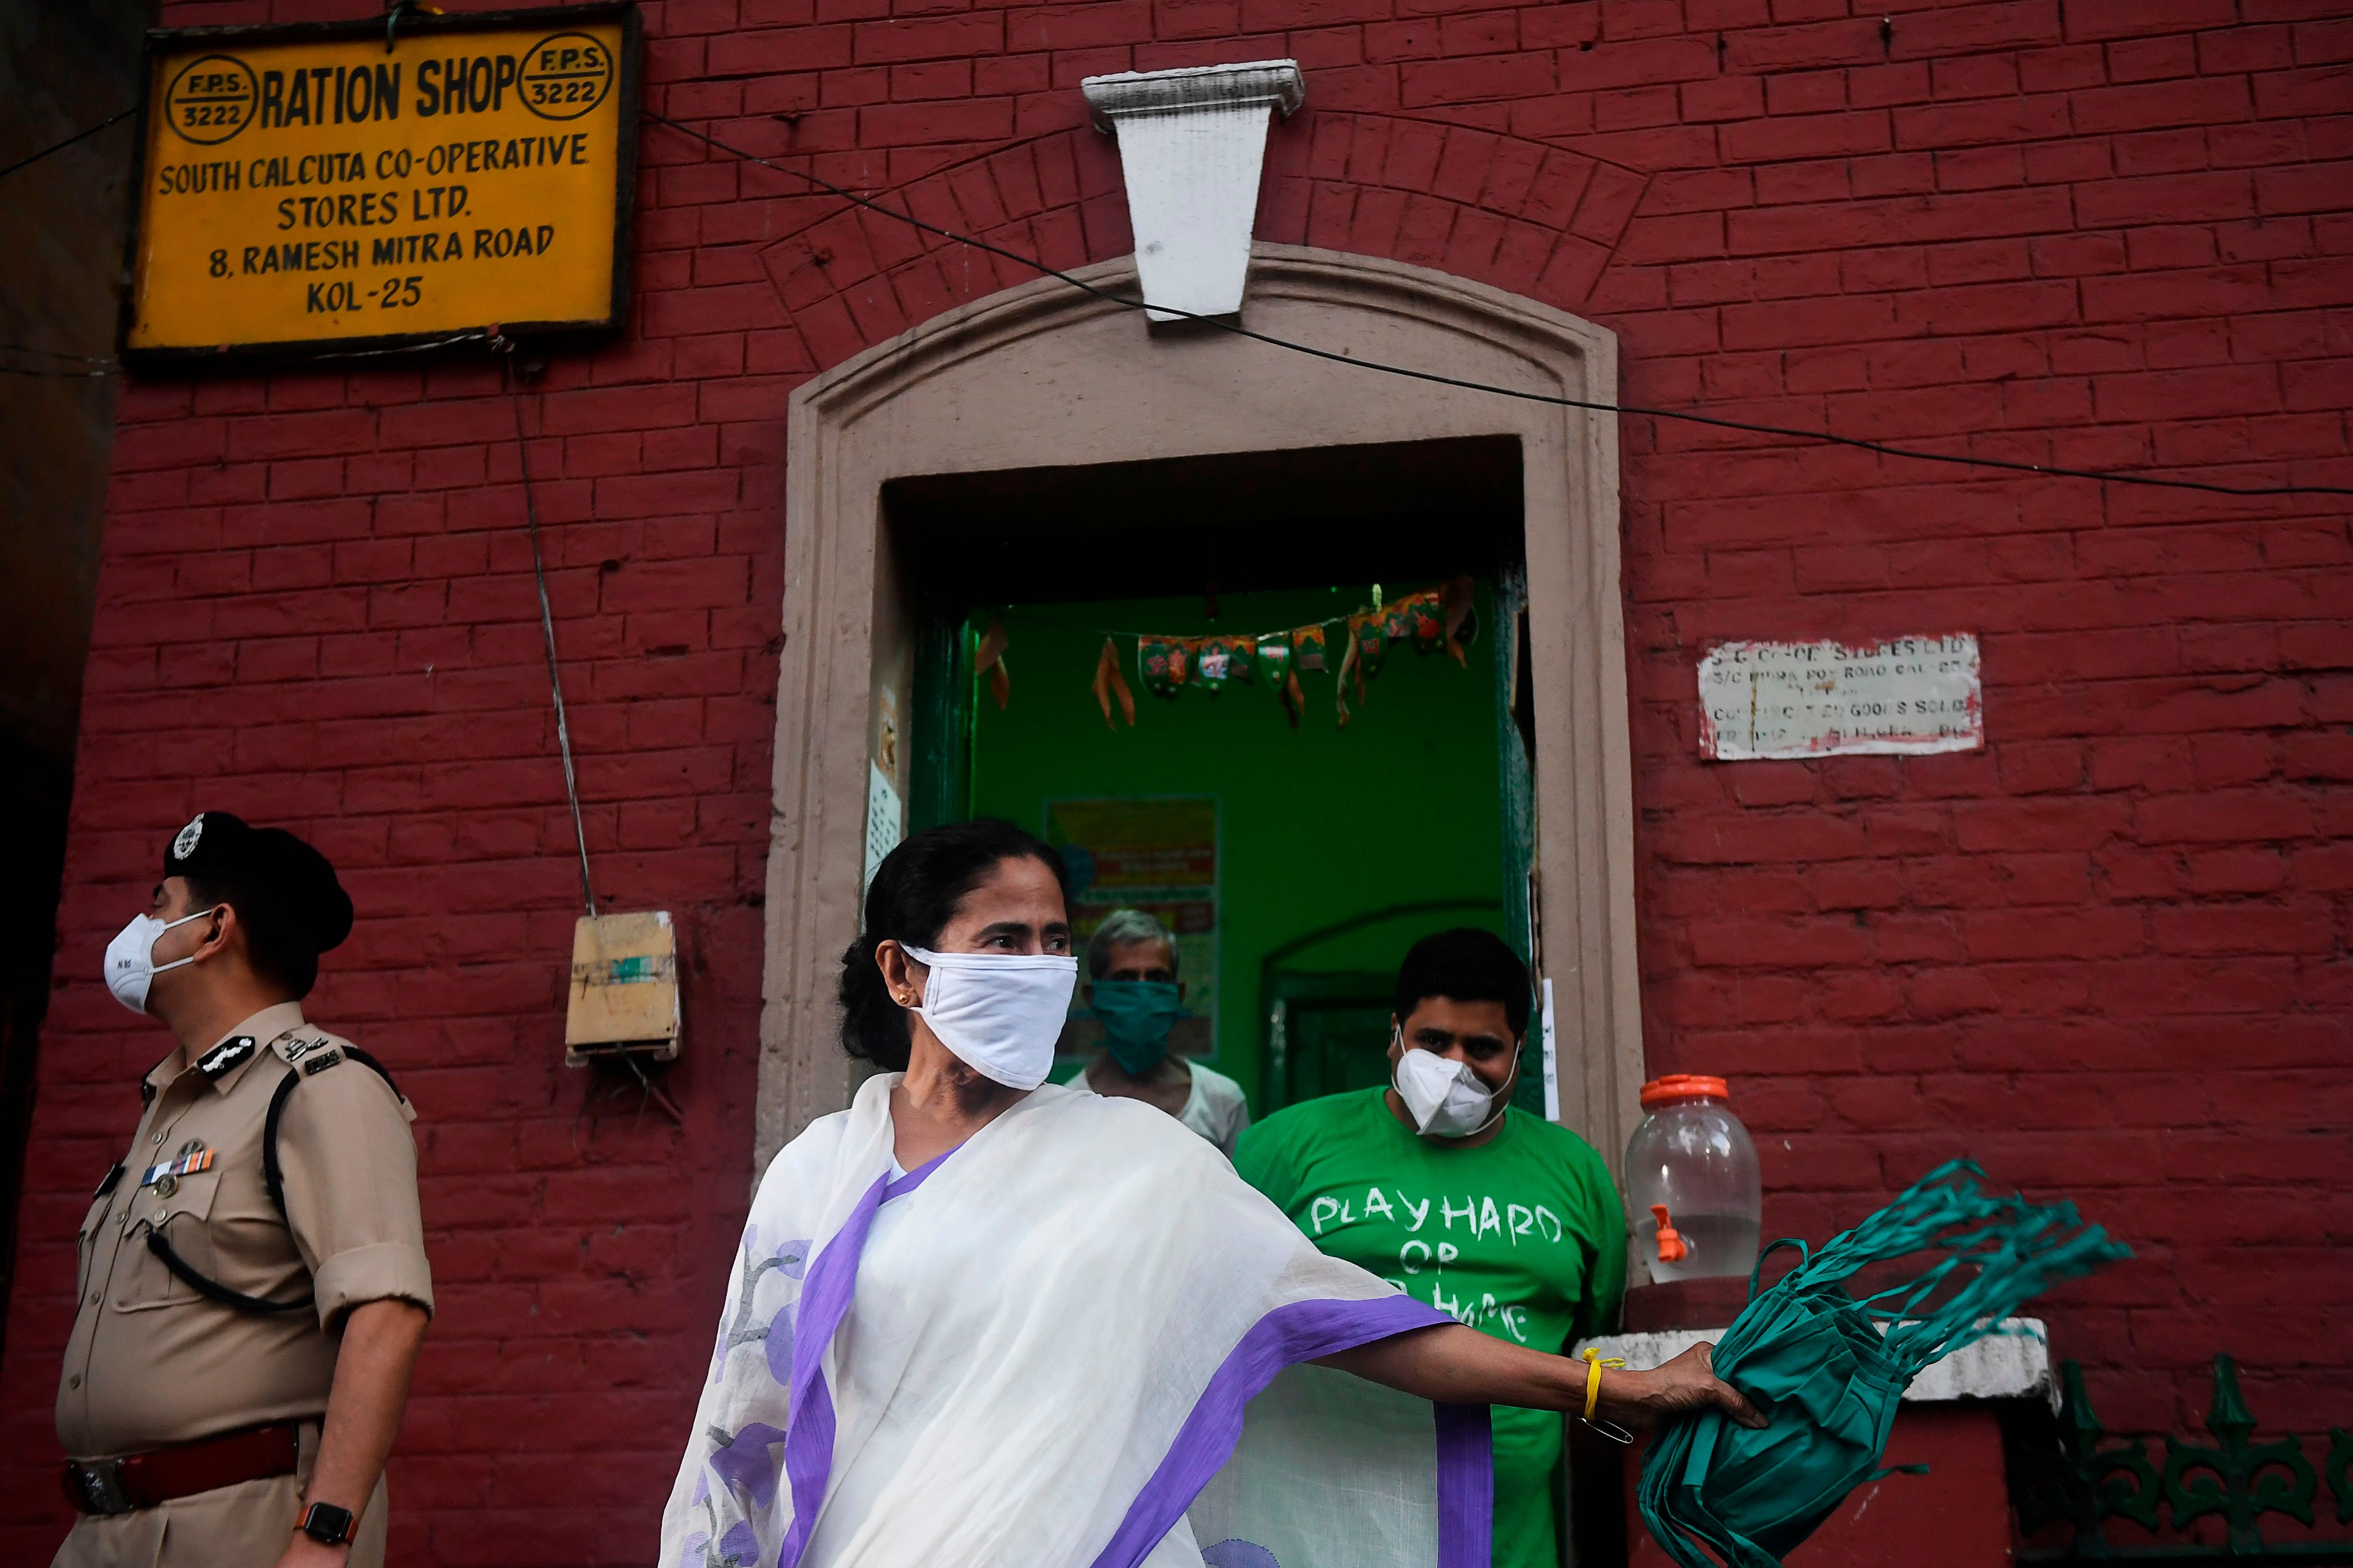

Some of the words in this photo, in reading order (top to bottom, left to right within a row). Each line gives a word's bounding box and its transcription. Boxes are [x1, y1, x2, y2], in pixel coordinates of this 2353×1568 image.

[541, 47, 605, 72] F.P.S.
[188, 73, 247, 93] F.P.S.
[261, 62, 402, 129] RATION
[417, 54, 516, 118] SHOP
[532, 81, 595, 105] 3222
[183, 105, 240, 127] 3222
[159, 160, 241, 196] SOUTH
[249, 152, 365, 188] CALCUTA
[376, 133, 589, 180] CO-OPERATIVE
[277, 192, 398, 230] STORES
[413, 185, 471, 222] LTD.
[210, 248, 234, 279] 8,
[243, 240, 359, 274] RAMESH
[372, 232, 463, 265] MITRA
[474, 225, 554, 259] ROAD
[1311, 1187, 1430, 1235] PLAY
[1440, 1195, 1561, 1247] HARD
